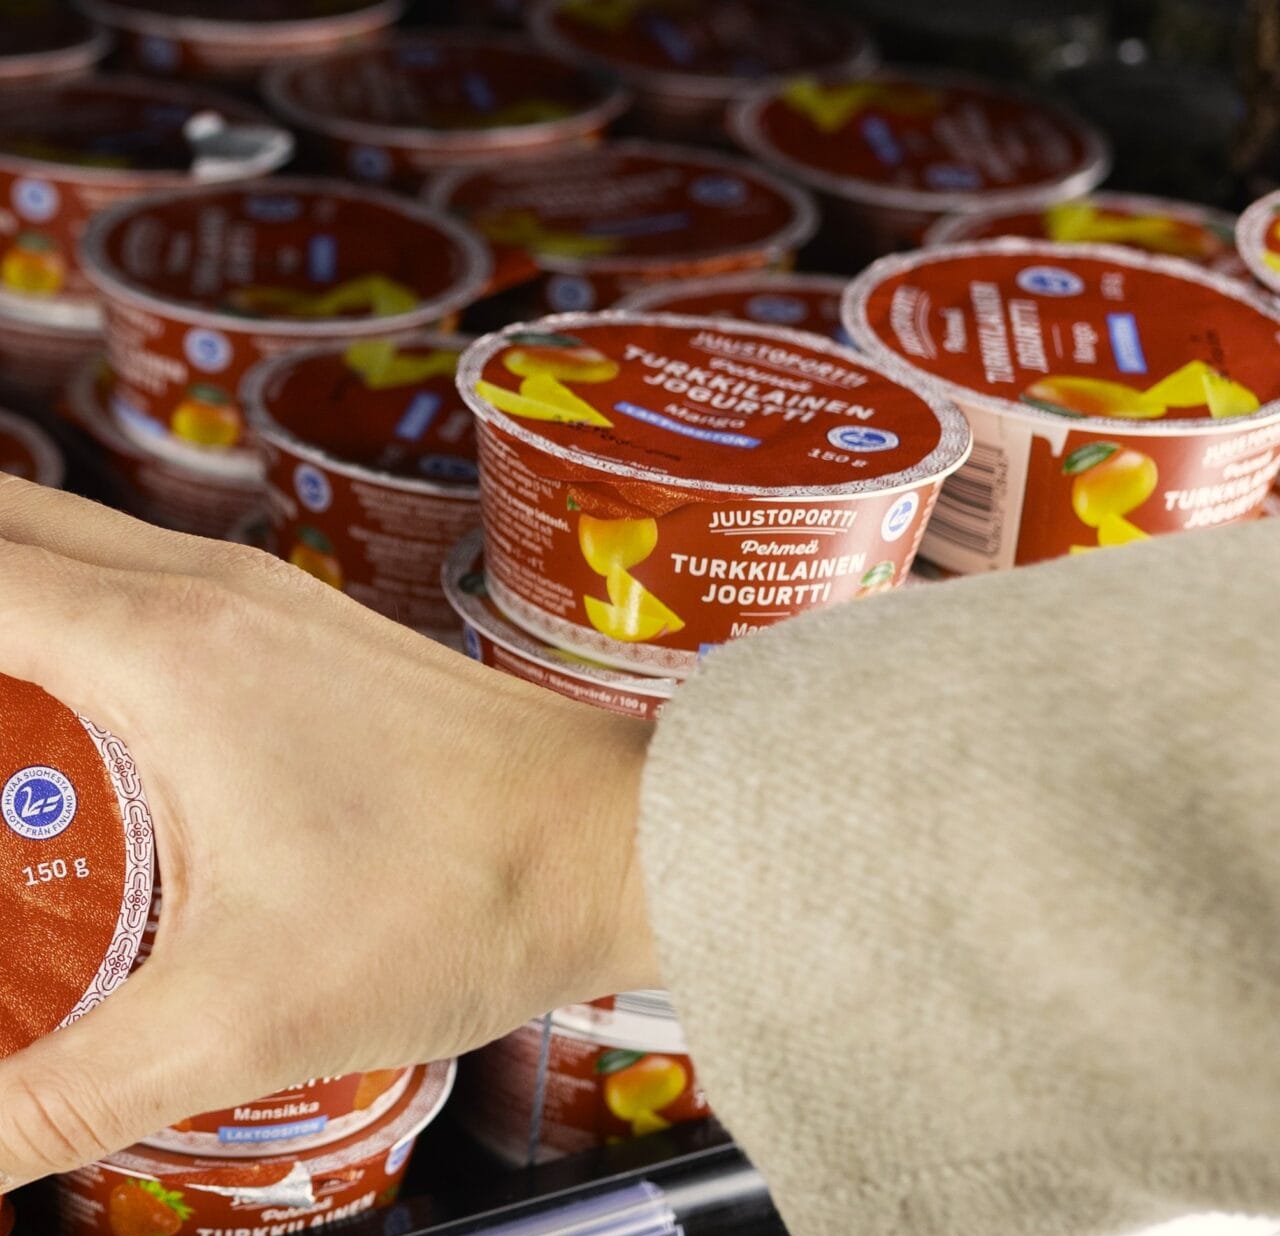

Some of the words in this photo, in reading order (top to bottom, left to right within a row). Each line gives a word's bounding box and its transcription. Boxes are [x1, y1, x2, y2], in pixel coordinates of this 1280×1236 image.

[623, 343, 875, 421] TURKKILAINEN
[643, 372, 816, 424] JOGURTTI
[709, 508, 857, 528] JUUSTOPORTTI
[740, 539, 819, 557] Pehmeä
[671, 551, 866, 581] TURKKILAINEN
[702, 582, 831, 606] JOGURTTI
[23, 858, 69, 886] 150
[74, 858, 90, 880] g
[233, 1101, 320, 1121] Mansikka
